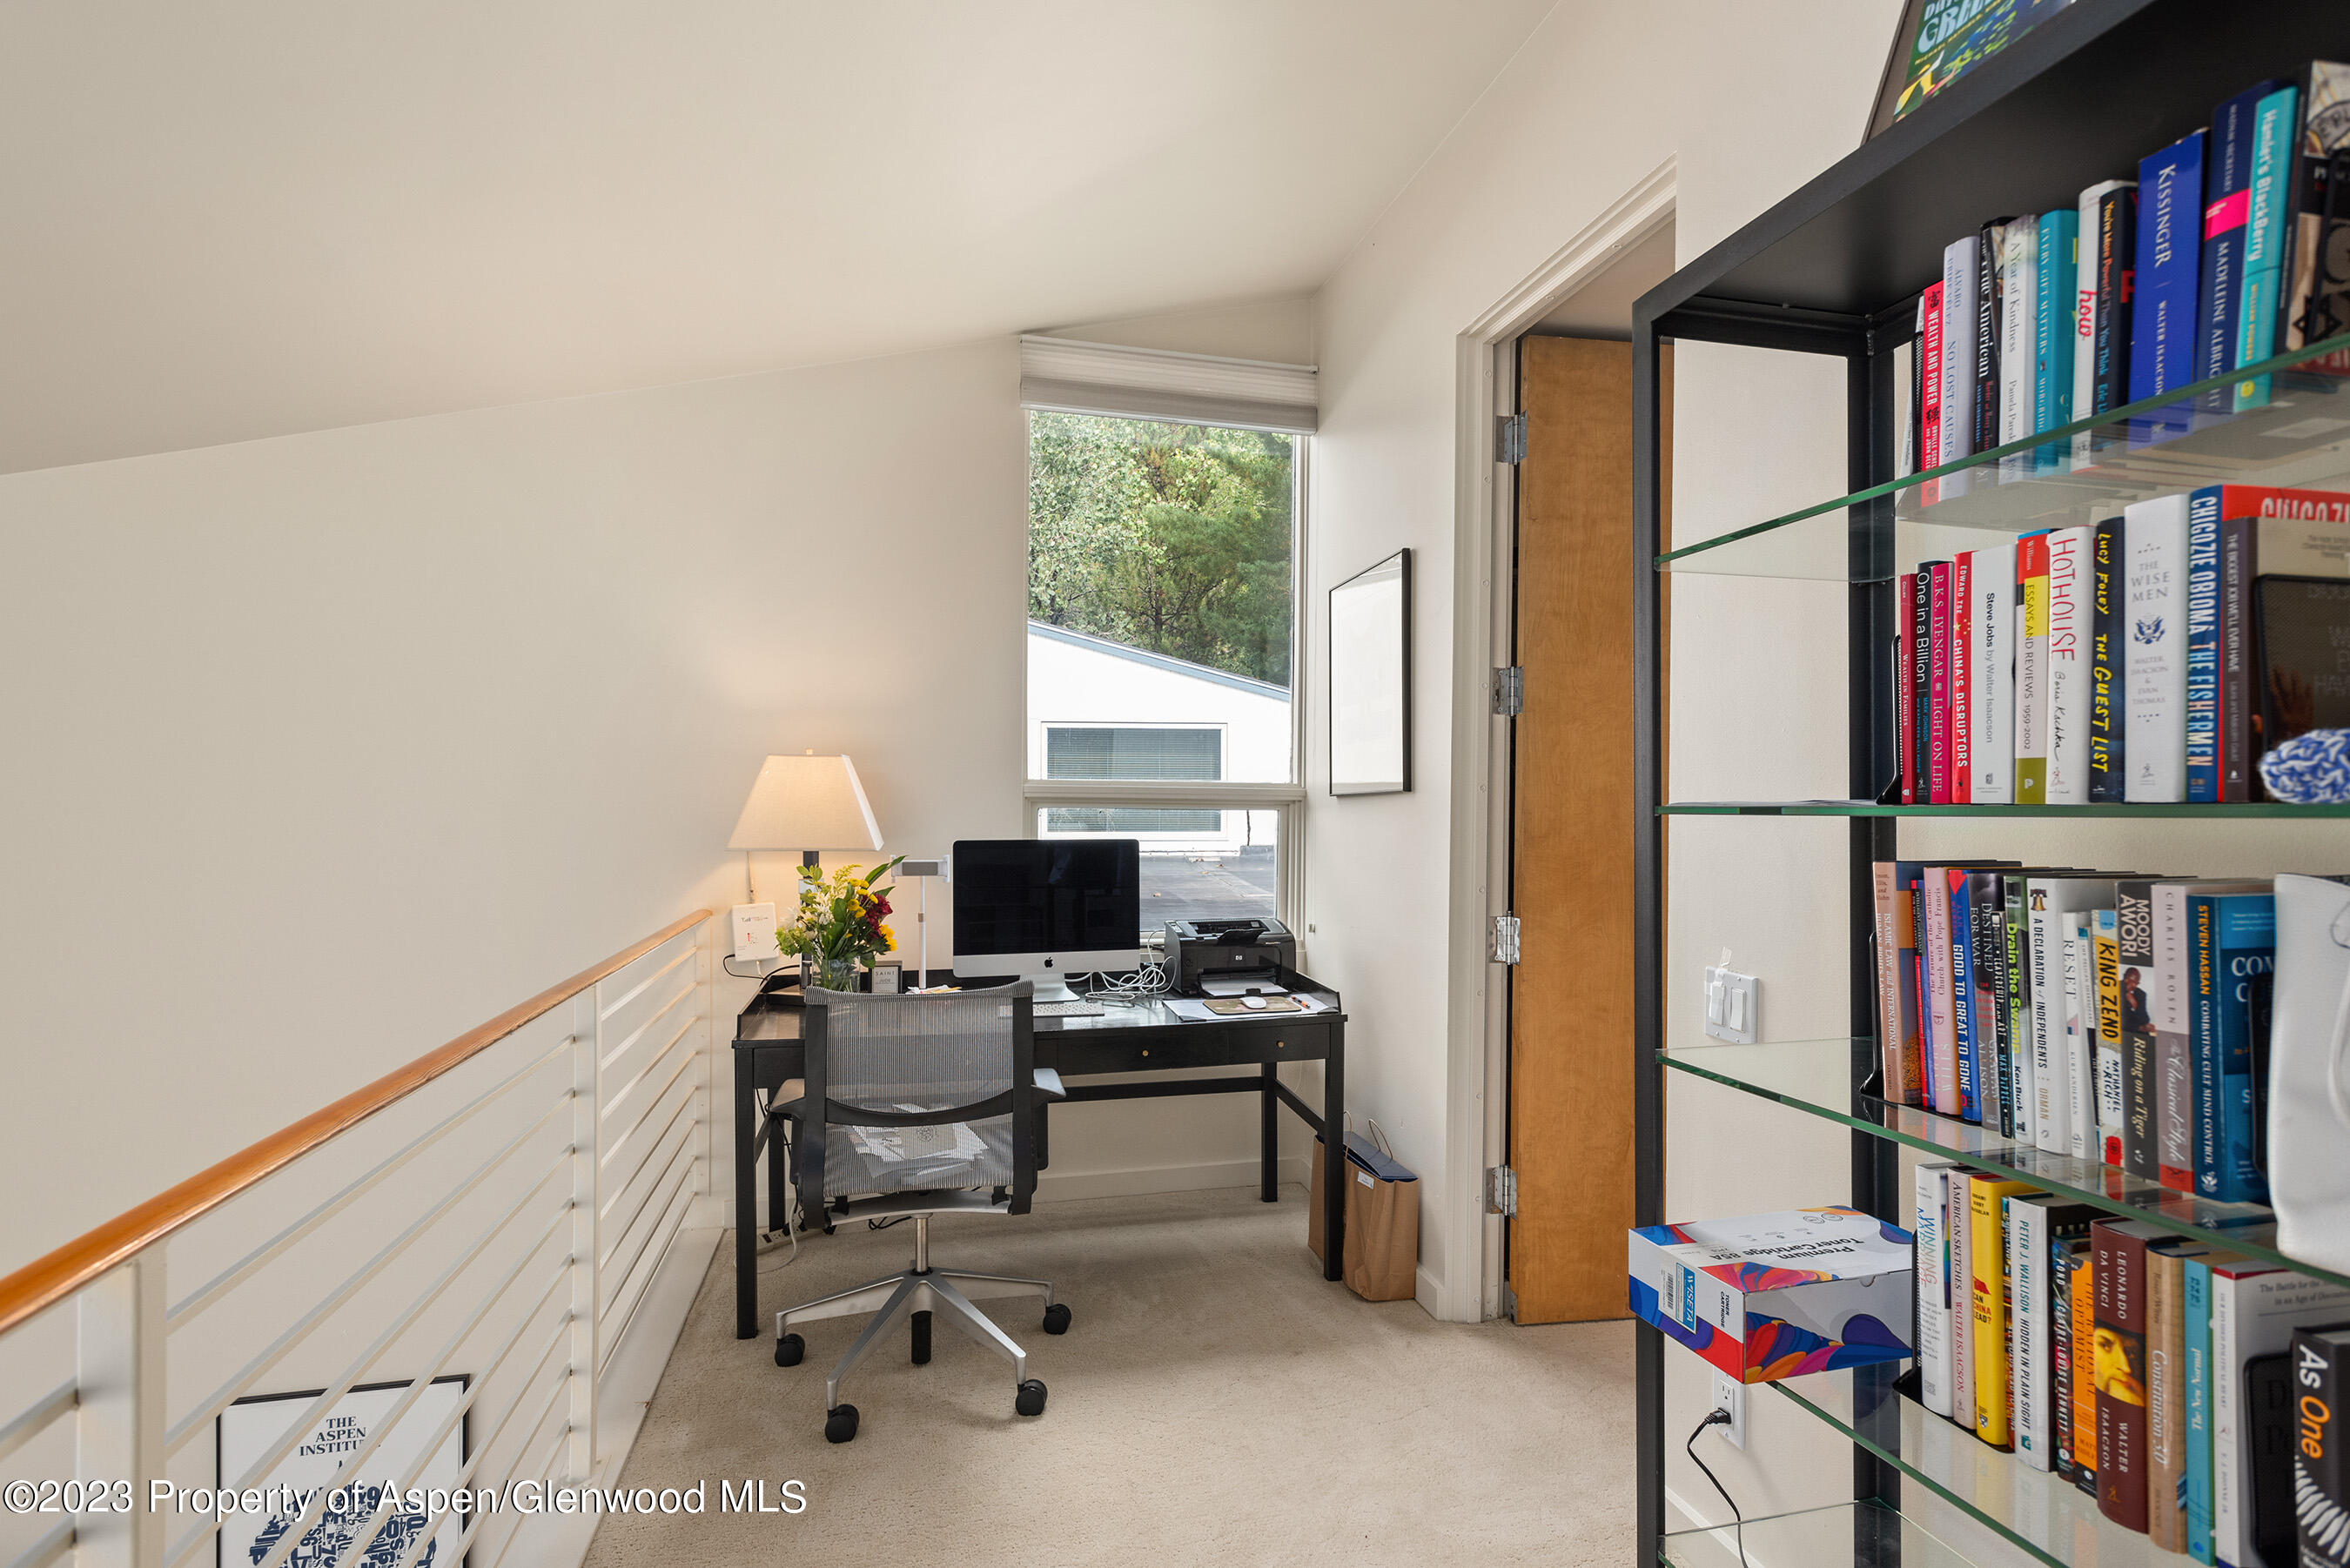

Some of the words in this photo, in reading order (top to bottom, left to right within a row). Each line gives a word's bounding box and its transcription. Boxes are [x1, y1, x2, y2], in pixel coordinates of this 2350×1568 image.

[2257, 108, 2279, 174] Hamlet's
[2104, 201, 2116, 232] You're
[2154, 163, 2177, 269] KISSINGER
[2246, 175, 2273, 263] BlackBerry
[2039, 227, 2051, 265] EVERY
[2103, 233, 2115, 258] More
[2039, 270, 2051, 296] GIFT
[2101, 258, 2114, 298] Powerful
[2213, 241, 2231, 325] MADELEINE
[1927, 310, 1941, 349] WEALTH
[2010, 299, 2022, 352] Kindness
[2038, 301, 2049, 355] MATTERS
[2078, 290, 2098, 338] how
[2100, 300, 2112, 326] Than
[2157, 299, 2168, 343] WALTER
[1946, 340, 1957, 362] NO
[1978, 302, 1995, 378] American
[2099, 328, 2111, 347] You
[1927, 350, 1940, 370] AND
[2098, 348, 2111, 376] Think
[2153, 345, 2165, 398] ISAACSON
[1927, 371, 1940, 406] POWER
[1945, 365, 1956, 399] LOST
[1944, 405, 1956, 458] CAUSES
[2096, 532, 2112, 565] LUCY
[2189, 496, 2217, 568] CHIGOZIE
[2026, 539, 2035, 571] Williams
[2138, 560, 2159, 573] THE
[2226, 551, 2239, 585] BIGGEST
[1915, 572, 1930, 604] One
[1933, 572, 1946, 612] B.K.S.
[1956, 564, 1968, 595] EDWARD
[2095, 571, 2110, 614] FOLEY
[2131, 573, 2172, 592] WISE
[2132, 587, 2169, 604] MEN
[1916, 606, 1929, 622] in
[1956, 600, 1966, 614] TSE
[1986, 592, 1996, 621] Steve
[2026, 584, 2037, 621] ESSAYS
[2050, 537, 2078, 661] HOTHOUSE
[2188, 570, 2216, 636] OBIOMA
[1916, 626, 1925, 635] a
[1934, 614, 1947, 679] IYENGAR
[1986, 622, 1996, 648] Jobs
[2025, 623, 2035, 649] AND
[2094, 633, 2108, 661] THE
[2228, 627, 2240, 649] EVER
[1916, 638, 1930, 683] Billion
[1954, 639, 1964, 688] CHINA'S
[1984, 650, 1995, 662] by
[2130, 665, 2169, 677] ISAACSON
[2133, 653, 2165, 666] WALTER
[2188, 641, 2216, 668] THE
[2228, 650, 2240, 673] HAVE
[1985, 663, 1994, 694] Walter
[2024, 653, 2034, 699] REVIEWS
[1931, 697, 1945, 736] LIGHT
[2092, 667, 2112, 732] GUEST
[2132, 696, 2166, 706] THOMAS
[1955, 691, 1969, 768] DISRUPTORS
[1985, 695, 1994, 744] Isaacson
[2024, 704, 2032, 750] 1959-2002
[2053, 705, 2067, 762] Kachka
[2186, 672, 2215, 766] FISHERMEN
[1931, 740, 1944, 761] ON
[2090, 735, 2110, 773] LIST
[1931, 763, 1944, 793] LIFE
[1934, 887, 1943, 916] Francis
[1884, 913, 1893, 947] ISLAMIC
[1934, 921, 1946, 941] Pope
[1970, 907, 1979, 934] FOR
[1981, 902, 1994, 972] DESTINED
[2119, 894, 2138, 958] AWORI
[2136, 899, 2152, 956] MOODY
[2165, 891, 2176, 962] CHARLES
[2198, 905, 2211, 948] STEVEN
[1935, 944, 1944, 962] with
[1952, 944, 1965, 976] GOOD
[1971, 937, 1982, 967] WAR
[2007, 922, 2020, 965] Drain
[2033, 928, 2046, 988] DECLARATION
[1886, 968, 1895, 986] and
[1935, 967, 1945, 995] Church
[2008, 967, 2022, 994] the
[2063, 939, 2077, 996] RESET
[2098, 942, 2118, 988] KING
[2199, 950, 2212, 995] HASSAN
[1954, 981, 1967, 997] TO
[2166, 974, 2177, 1025] ROSEN
[1887, 987, 1897, 1051] INTERNATIONAL
[1956, 1000, 1969, 1036] GREAT
[2010, 997, 2024, 1055] Swamp
[2036, 1001, 2049, 1069] INDEPENDENTS
[2100, 995, 2120, 1040] ZENO
[2200, 1000, 2212, 1059] COMBATING
[1957, 1040, 1970, 1055] TO
[2130, 1036, 2147, 1079] Riding
[1958, 1057, 1971, 1092] GONE
[1977, 1040, 1989, 1097] ALLISON
[2103, 1069, 2112, 1099] RICH
[2111, 1059, 2121, 1114] NATHANIEL
[2134, 1080, 2145, 1092] on
[2201, 1061, 2212, 1086] CULT
[2015, 1086, 2024, 1113] Buck
[2038, 1087, 2050, 1121] ORMAN
[2134, 1096, 2145, 1104] a
[2166, 1055, 2186, 1123] Classical
[2202, 1087, 2213, 1117] MIND
[2131, 1105, 2149, 1139] Tiger
[2163, 1119, 2186, 1162] Style
[2203, 1117, 2214, 1166] CONTROL
[1952, 1182, 1964, 1236] AMERICAN
[1742, 1243, 1816, 1256] Cartridge
[1816, 1237, 1864, 1249] Toner
[1921, 1216, 1938, 1284] WINNING
[2018, 1218, 2031, 1251] PETER
[1777, 1246, 1856, 1260] Premium
[1953, 1236, 1964, 1291] SKETCHES
[2099, 1250, 2110, 1267] DA
[2019, 1264, 2031, 1315] WALLISON
[2055, 1258, 2066, 1286] POND
[2116, 1250, 2127, 1320] LEONARDO
[1686, 1276, 1695, 1323] WISETA
[2100, 1272, 2110, 1309] VINCI
[1955, 1301, 1964, 1334] WALTER
[2074, 1298, 2086, 1372] OPTIMIST
[2020, 1317, 2031, 1355] HIDDEN
[1956, 1335, 1965, 1393] ISAACSON
[2021, 1356, 2031, 1368] IN
[2191, 1347, 2203, 1385] Normal
[2299, 1344, 2329, 1390] As
[2021, 1369, 2031, 1397] PLAIN
[2151, 1350, 2169, 1438] Constitution
[2191, 1389, 2203, 1409] New
[326, 1416, 357, 1429] THE
[2021, 1398, 2032, 1431] SIGHT
[2058, 1387, 2070, 1433] BENNETT
[2191, 1411, 2204, 1431] The
[2300, 1395, 2331, 1459] One
[299, 1438, 366, 1457] INSTITU
[315, 1426, 366, 1443] ASPEN
[2101, 1406, 2111, 1471] ISAACSON
[2118, 1422, 2129, 1473] WALTER
